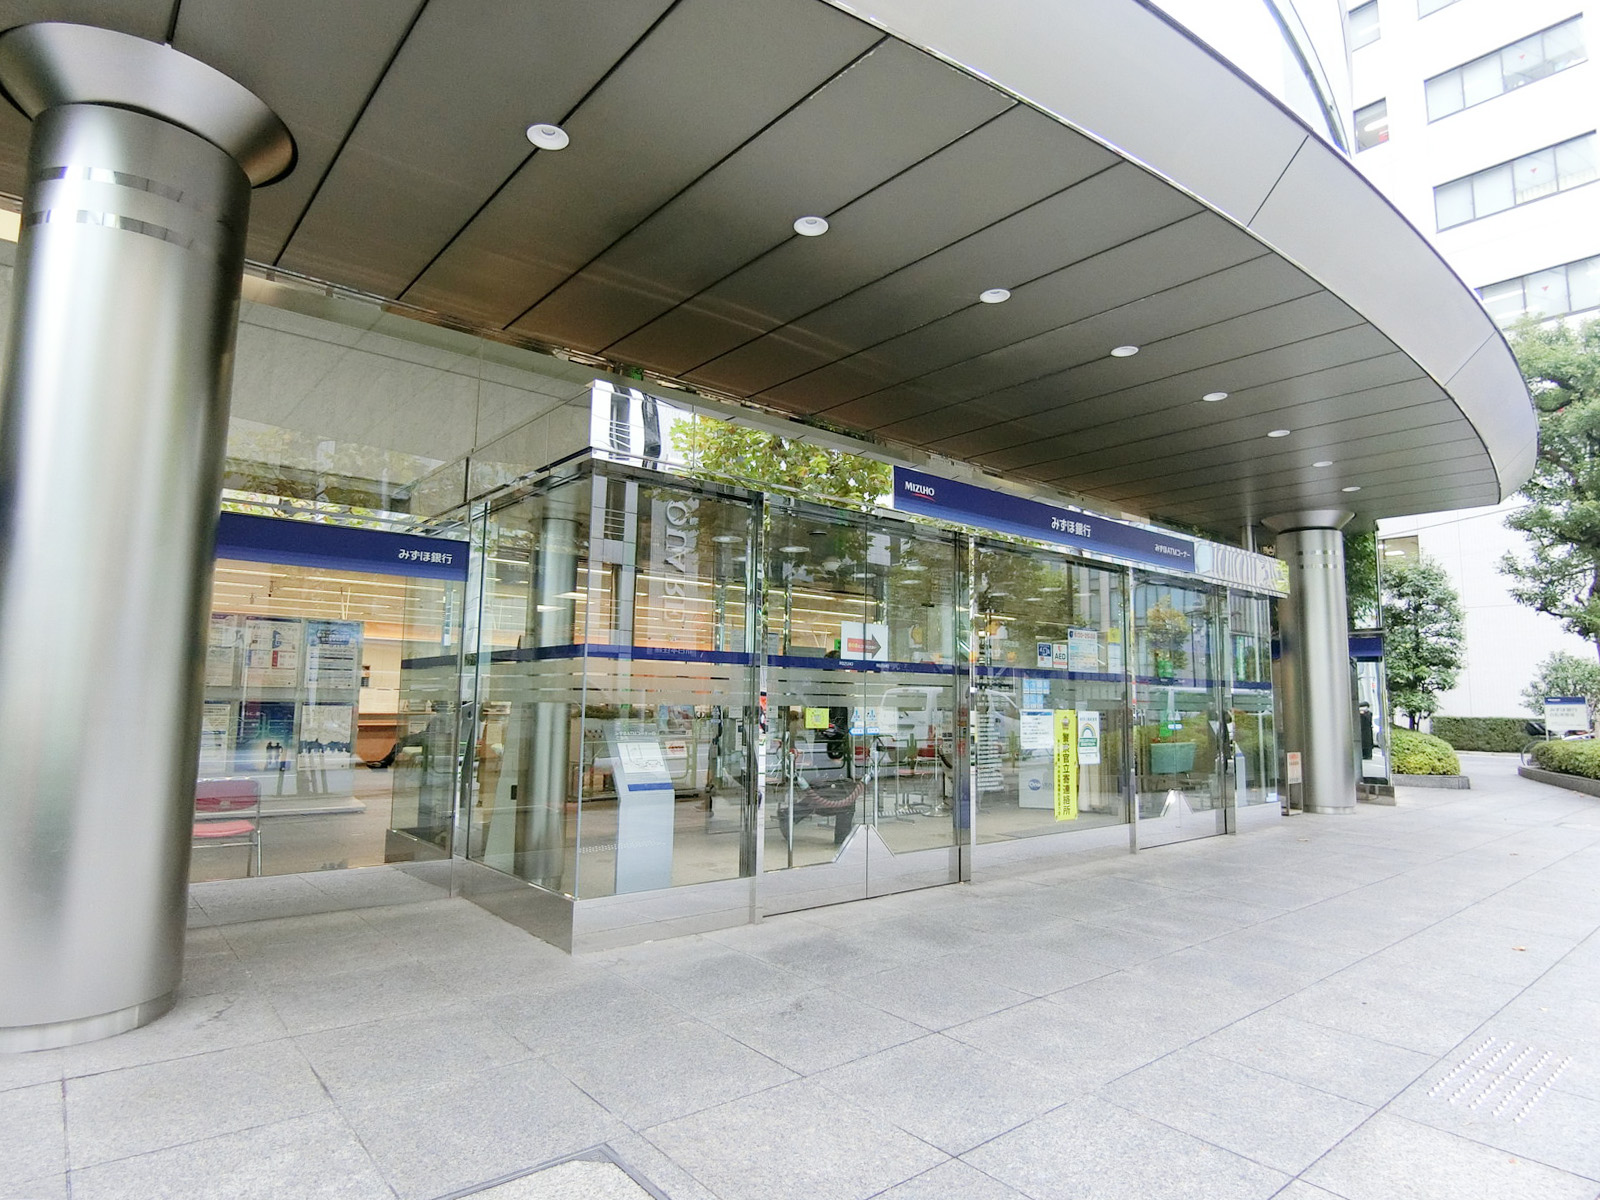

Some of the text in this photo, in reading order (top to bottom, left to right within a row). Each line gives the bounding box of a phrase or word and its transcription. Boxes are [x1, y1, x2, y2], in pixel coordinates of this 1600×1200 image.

[905, 481, 935, 496] MIZUHO
[1051, 516, 1091, 538] みずほ銀行
[398, 548, 453, 564] みずほ銀行
[1054, 652, 1067, 660] AED
